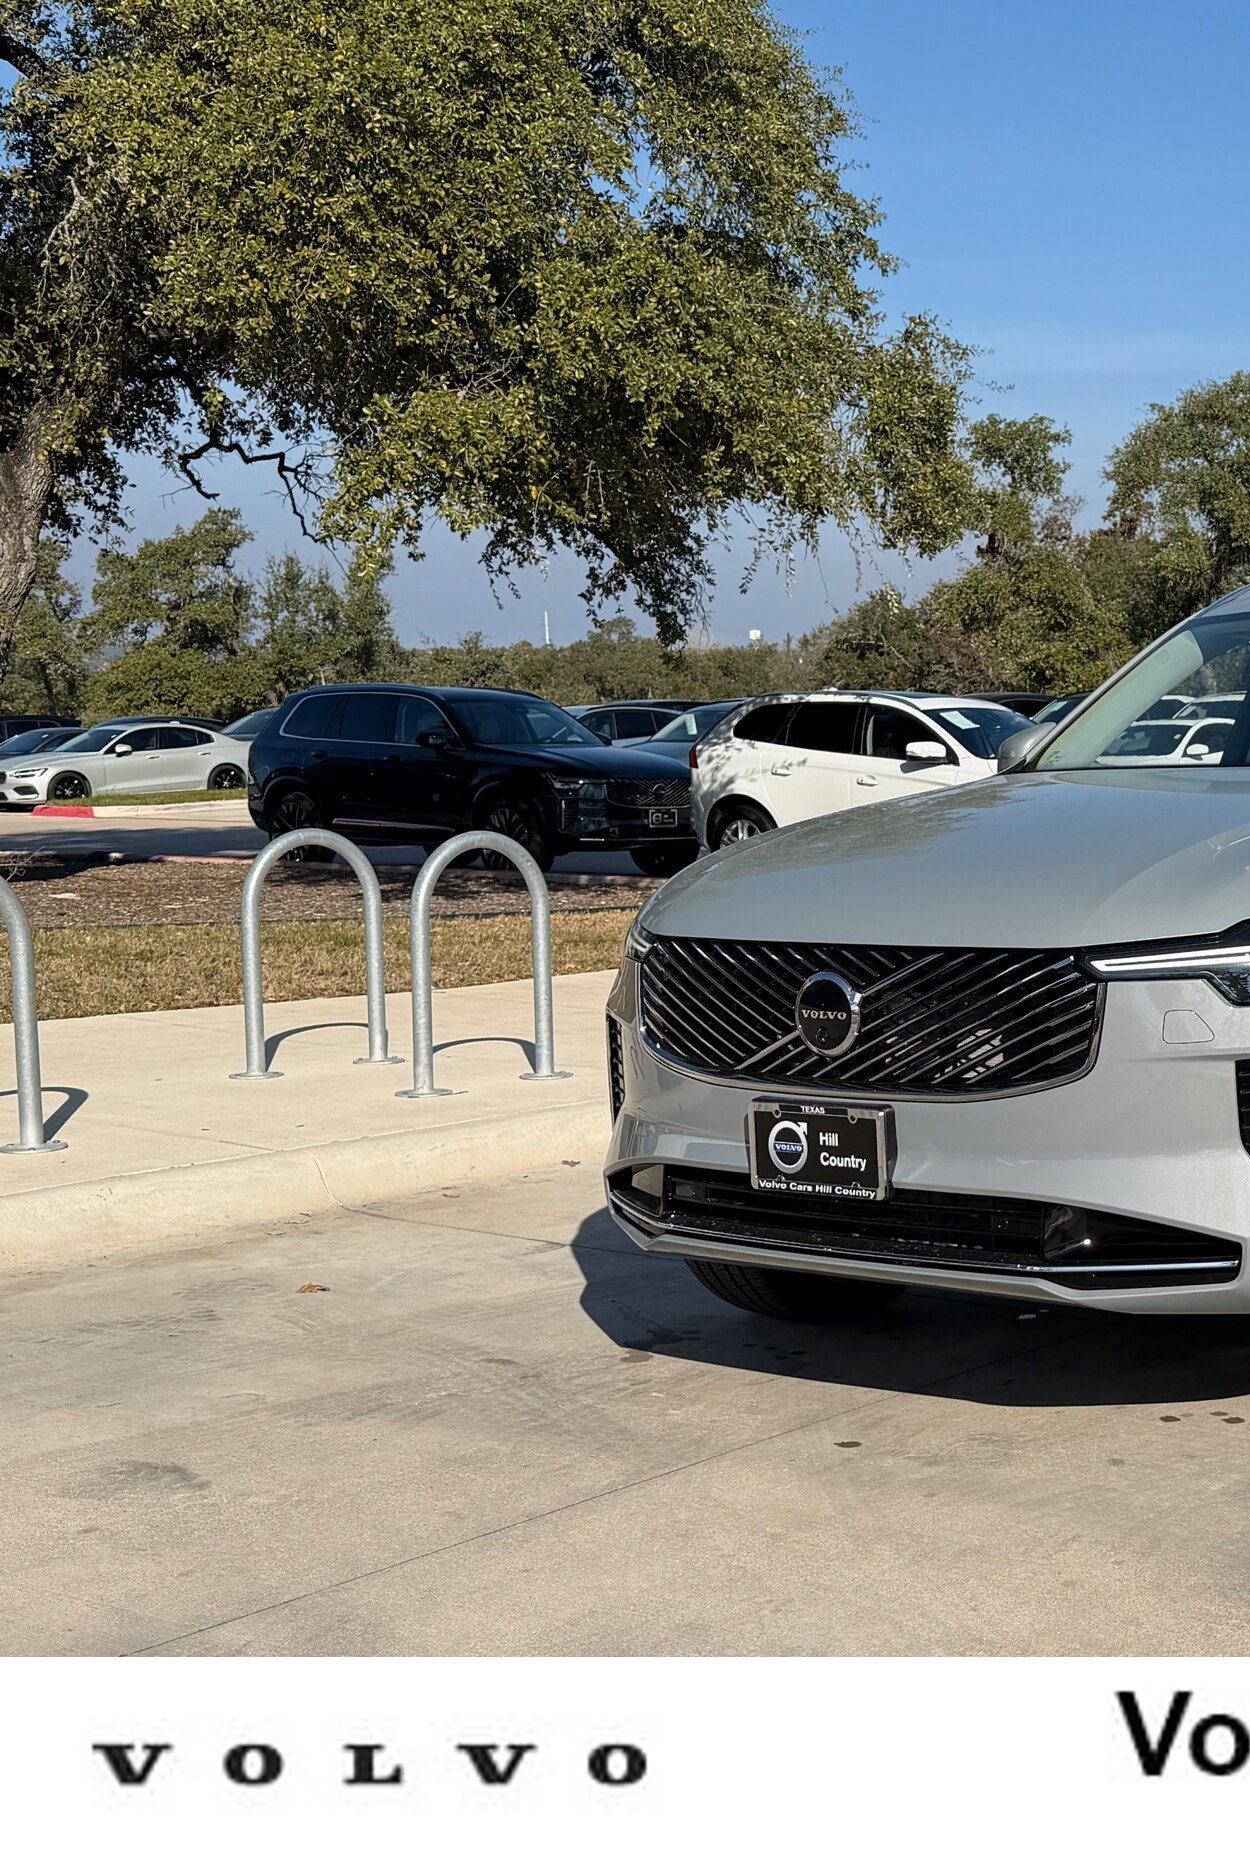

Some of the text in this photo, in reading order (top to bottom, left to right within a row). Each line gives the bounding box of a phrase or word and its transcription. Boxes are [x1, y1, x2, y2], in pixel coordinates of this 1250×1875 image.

[801, 1009, 847, 1020] VOLVO
[800, 1105, 825, 1114] TEXAS
[819, 1132, 838, 1147] Hill
[775, 1143, 802, 1152] VOLVO
[819, 1151, 867, 1172] Country
[759, 1180, 876, 1199] Volvo Cars Hill Country
